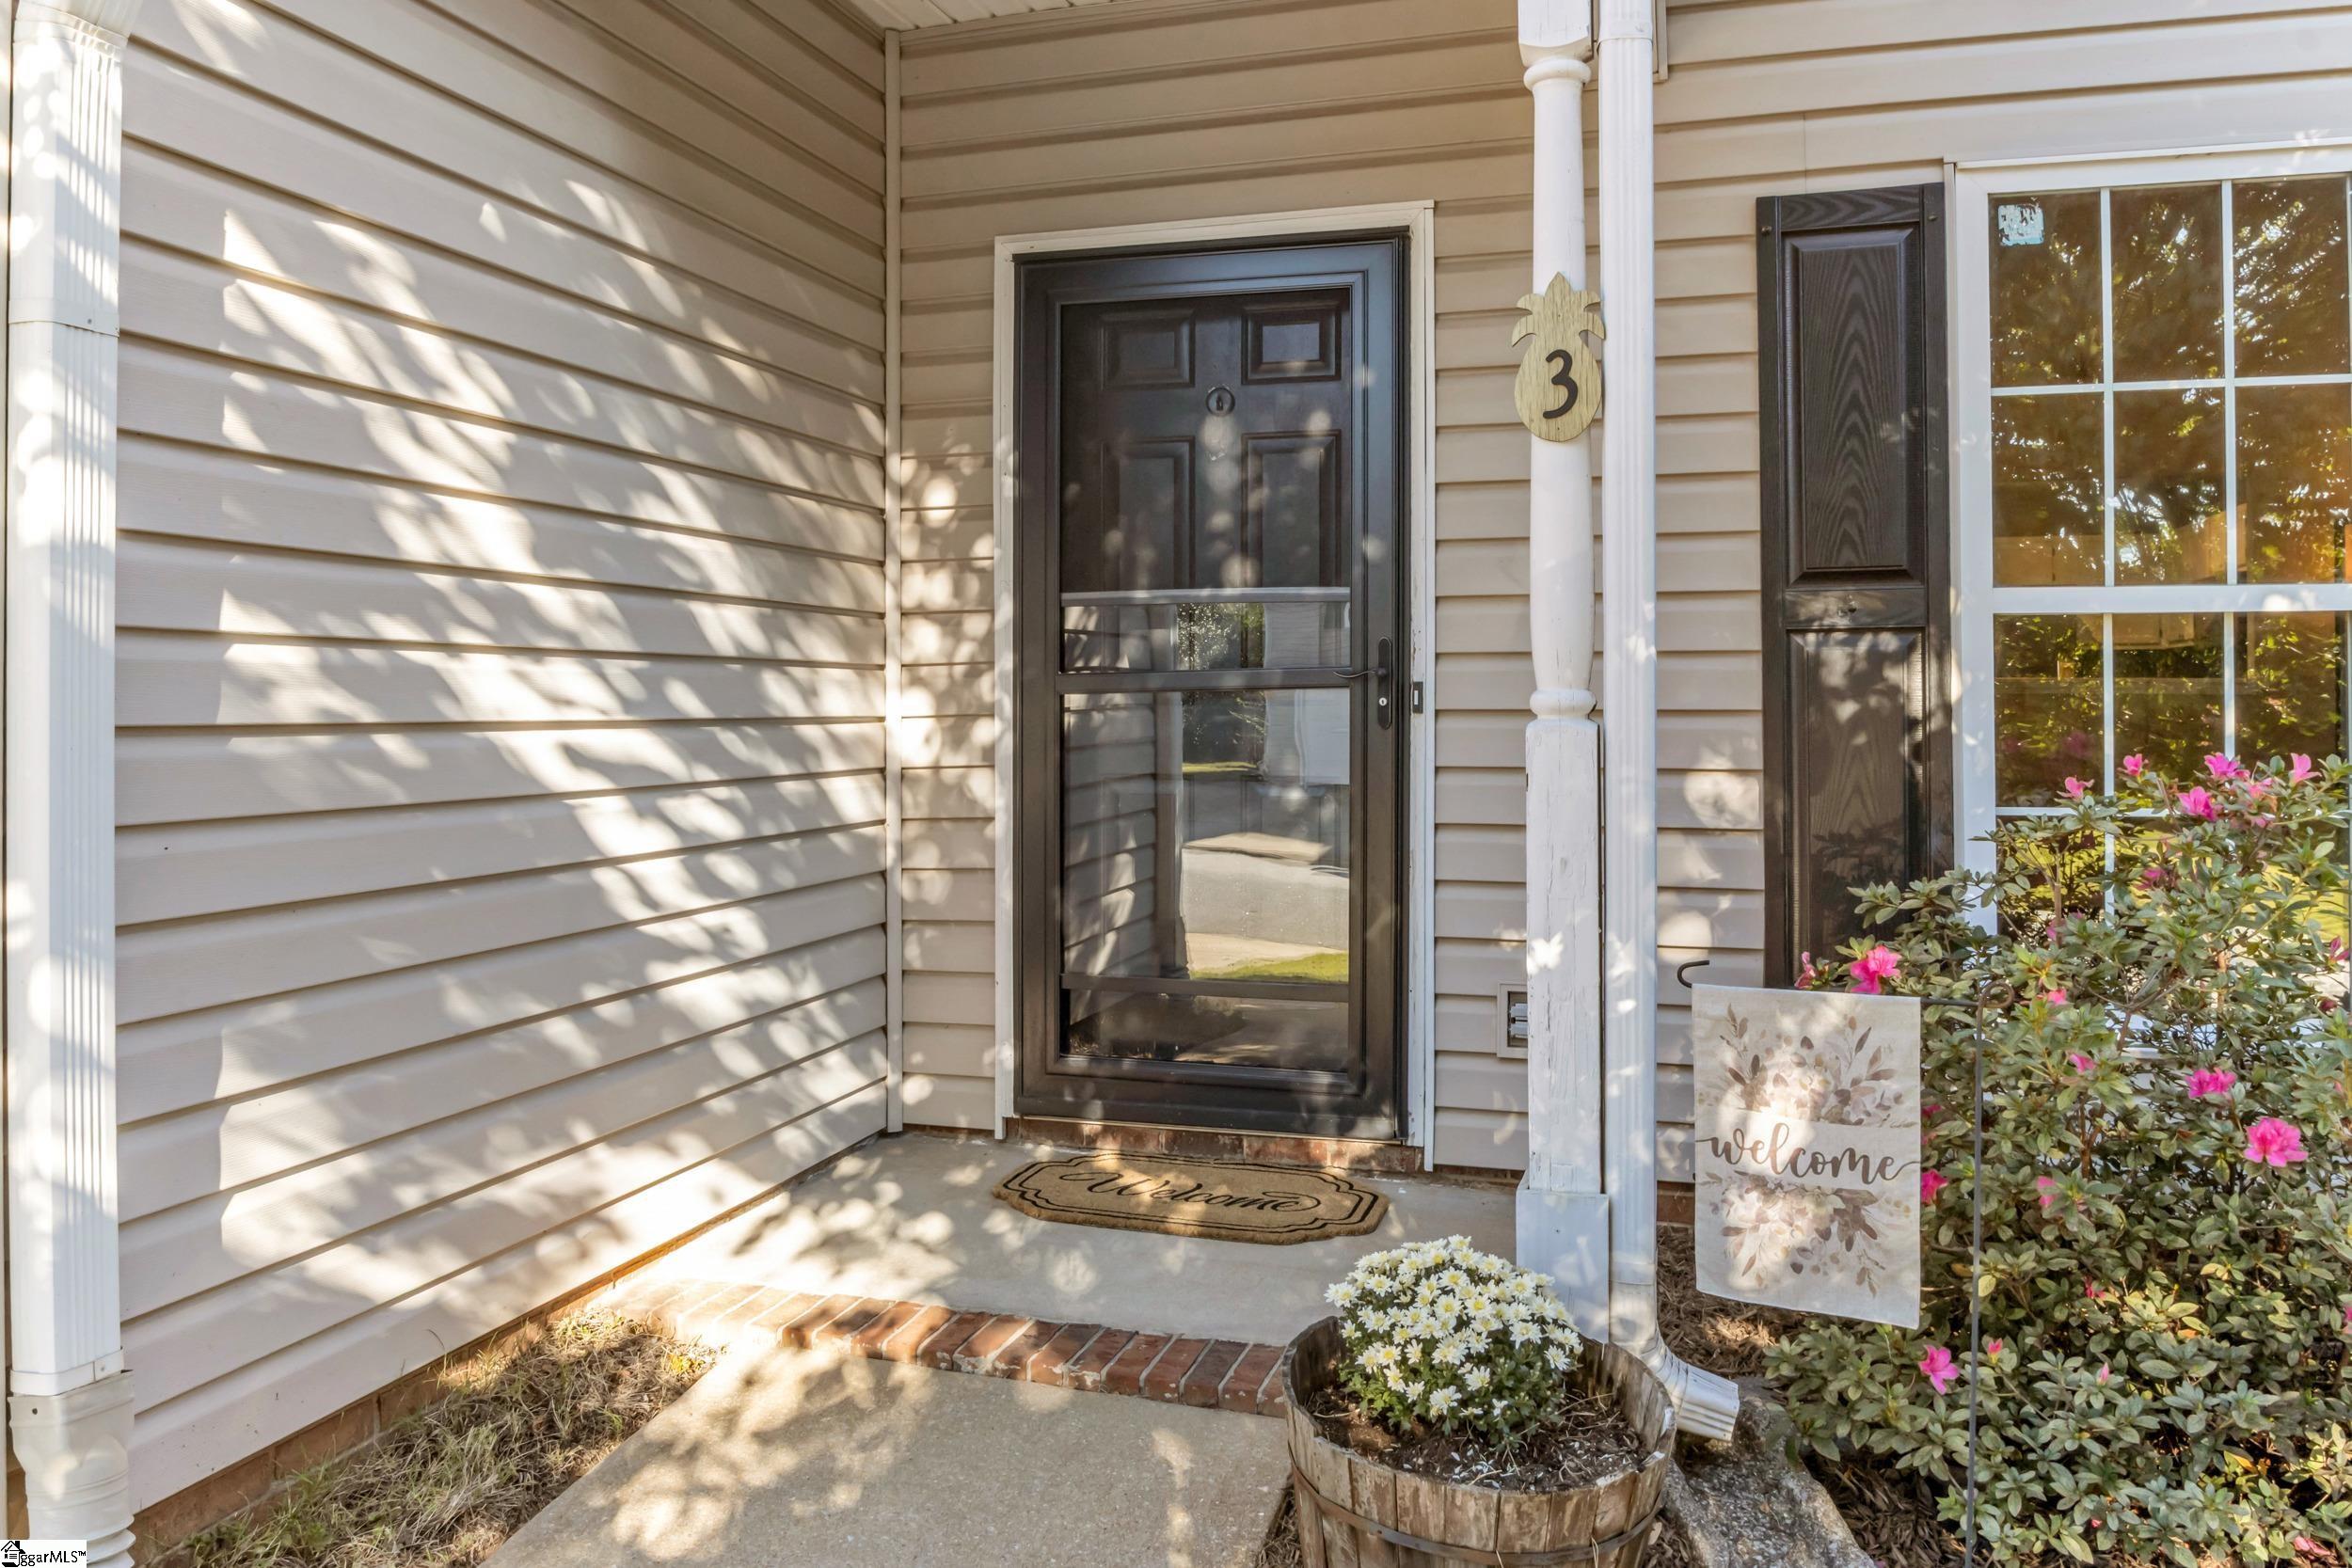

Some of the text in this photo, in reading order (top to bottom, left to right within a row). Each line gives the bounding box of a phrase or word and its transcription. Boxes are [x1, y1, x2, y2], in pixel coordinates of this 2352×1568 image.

[1542, 349, 1579, 420] 3
[1695, 1123, 1920, 1185] welcome
[1059, 1171, 1321, 1212] Welcome
